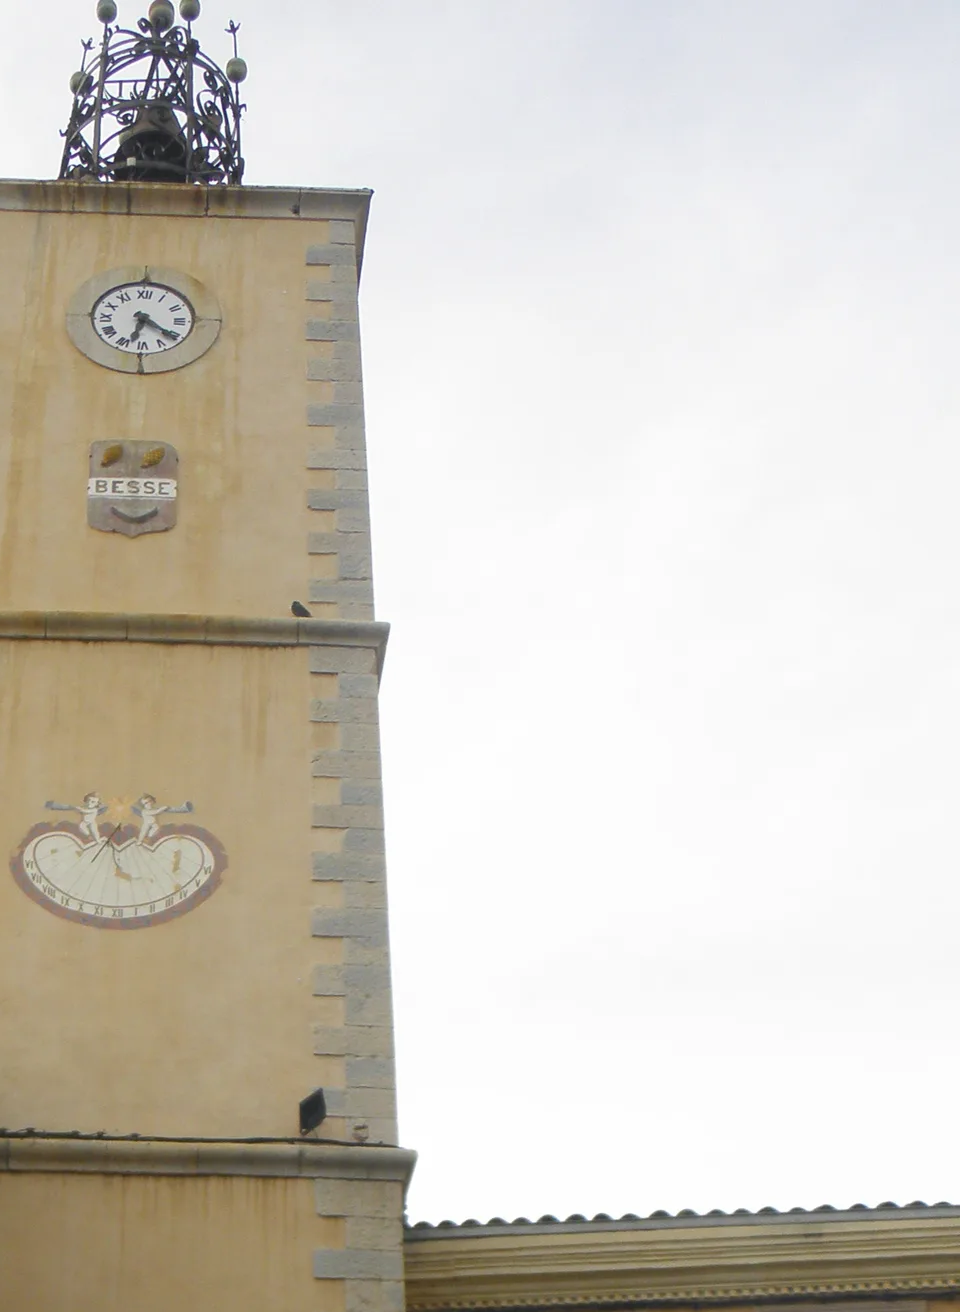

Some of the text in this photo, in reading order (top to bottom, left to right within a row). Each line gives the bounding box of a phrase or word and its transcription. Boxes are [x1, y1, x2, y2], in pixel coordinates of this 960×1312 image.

[116, 292, 132, 303] XI
[137, 290, 153, 299] XII
[104, 302, 119, 311] X
[168, 304, 182, 312] II
[99, 313, 113, 322] IX
[173, 317, 186, 326] III
[115, 336, 130, 348] VII
[137, 341, 149, 350] VI
[156, 338, 167, 348] V
[95, 480, 171, 495] BESSE
[25, 859, 34, 870] VI
[30, 872, 42, 884] VII
[42, 884, 56, 898] VIII
[60, 896, 70, 906] IX
[94, 905, 103, 916] XI
[111, 908, 124, 918] XII
